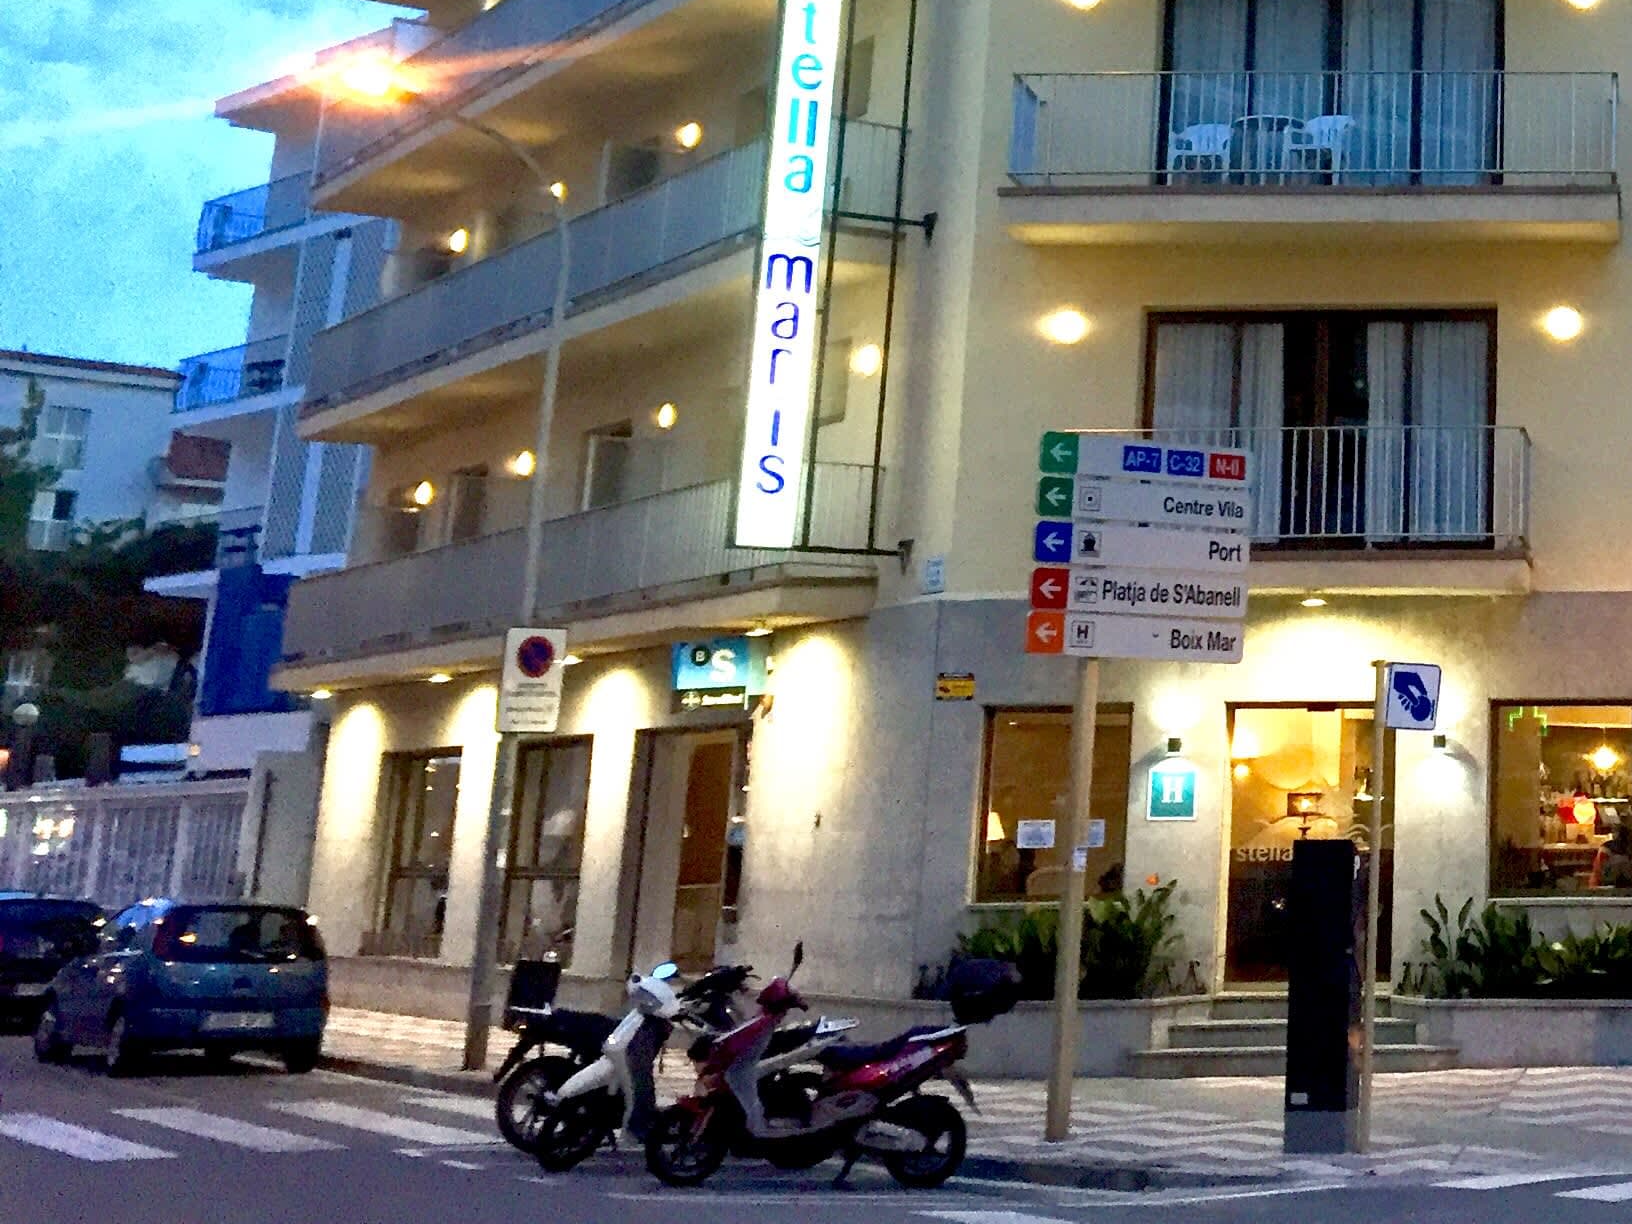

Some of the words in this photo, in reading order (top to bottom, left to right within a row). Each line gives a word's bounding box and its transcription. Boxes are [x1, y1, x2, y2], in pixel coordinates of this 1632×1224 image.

[756, 252, 814, 495] maris
[1125, 449, 1160, 468] AP-7
[1169, 454, 1201, 473] C-32
[1163, 496, 1214, 516] Centre
[1218, 500, 1244, 519] Vila
[1208, 541, 1242, 563] Port
[1102, 579, 1146, 606] Platja
[1150, 585, 1170, 603] de
[1172, 583, 1241, 606] S'Abanell
[1170, 629, 1203, 650] Boix
[1206, 632, 1237, 652] Mar
[1160, 775, 1185, 804] H
